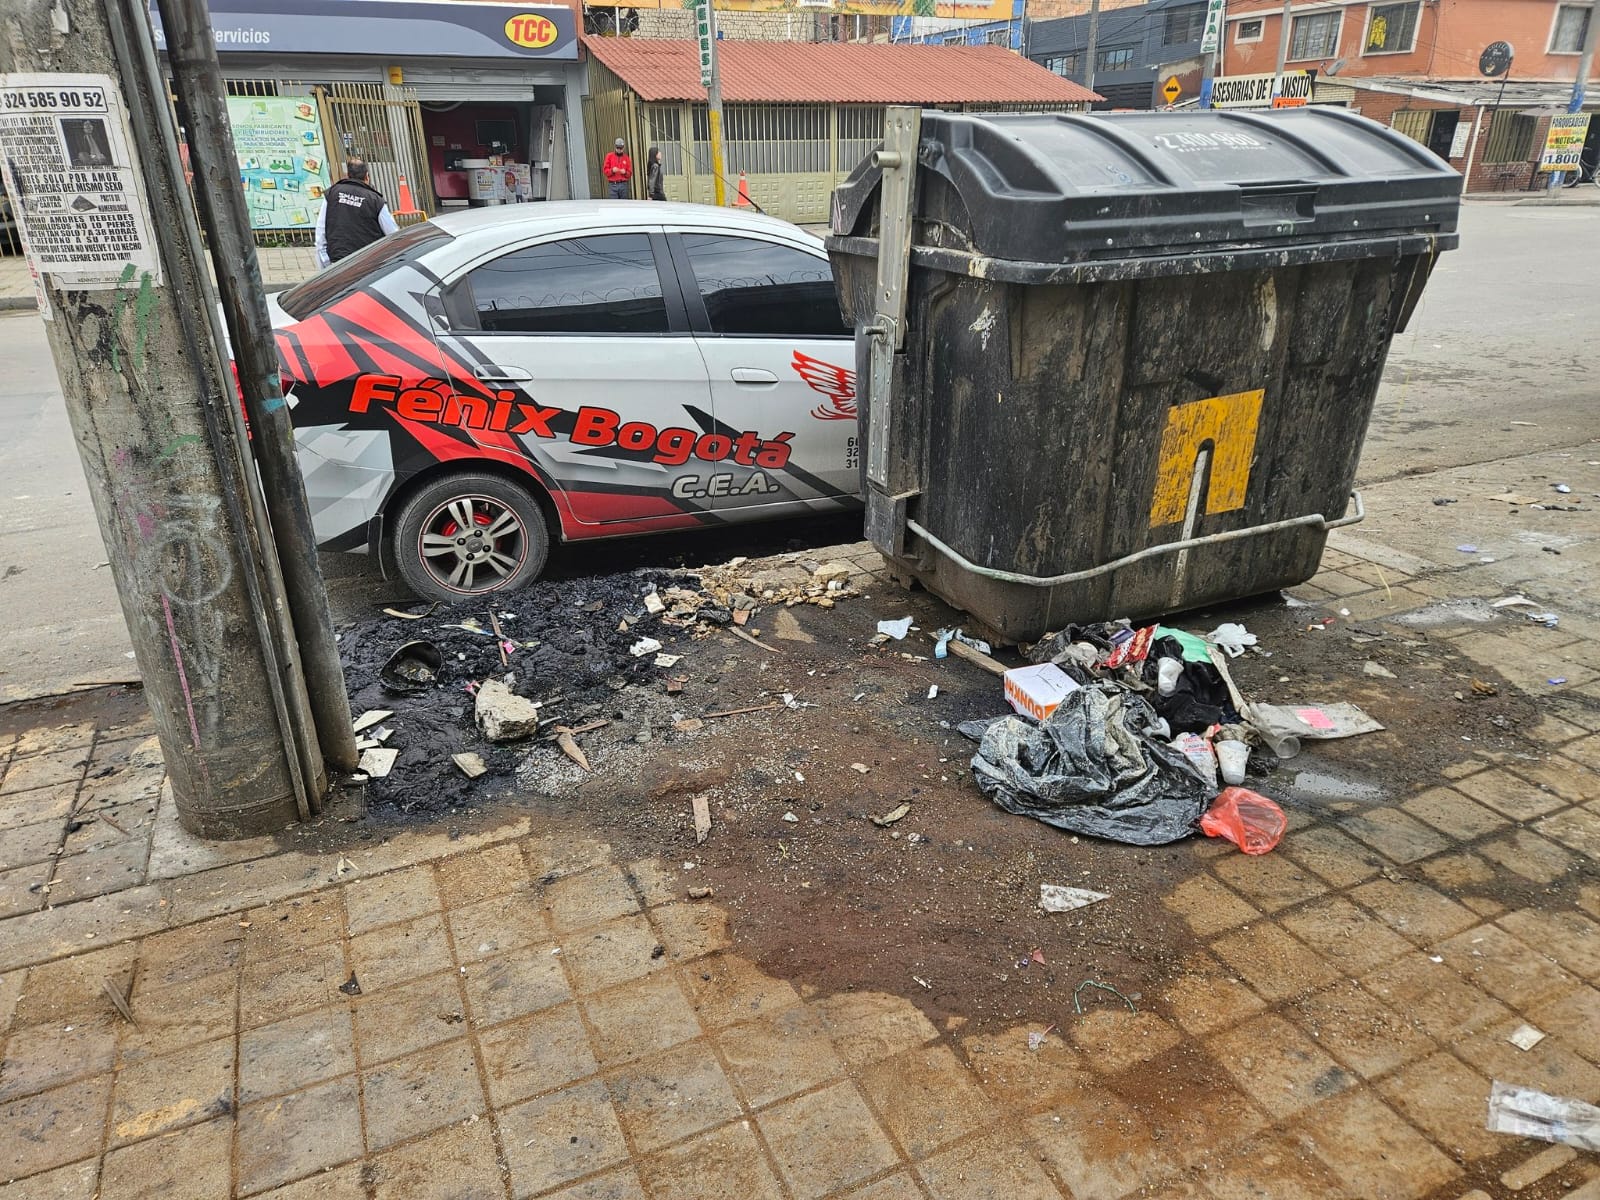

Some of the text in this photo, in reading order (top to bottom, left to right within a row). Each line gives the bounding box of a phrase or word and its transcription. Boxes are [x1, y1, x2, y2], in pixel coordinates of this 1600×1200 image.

[212, 27, 270, 44] ervicios
[511, 19, 551, 42] TCC
[1211, 75, 1310, 102] ASESORIAS DE TANSITO
[4, 92, 103, 108] 324 585 90 52
[43, 173, 65, 184] SOLO
[69, 173, 87, 183] POR
[34, 183, 62, 193] PAREJAS
[62, 183, 76, 192] DEL
[76, 182, 104, 192] MISMO
[104, 181, 123, 191] SEXO
[89, 214, 134, 222] REBELDES
[76, 222, 87, 230] NO
[60, 229, 80, 237] SOLO
[108, 227, 138, 235] HORAS
[104, 234, 139, 242] PAREJA
[84, 243, 107, 252] VUELVE
[112, 243, 121, 251] LO
[121, 242, 142, 251] HECHO
[70, 253, 92, 262] SEPARE
[101, 252, 117, 261] CITA
[348, 372, 796, 469] Fénix Bogotá
[846, 448, 859, 457] 32
[846, 459, 858, 469] 31
[672, 471, 781, 499] C.E.A.
